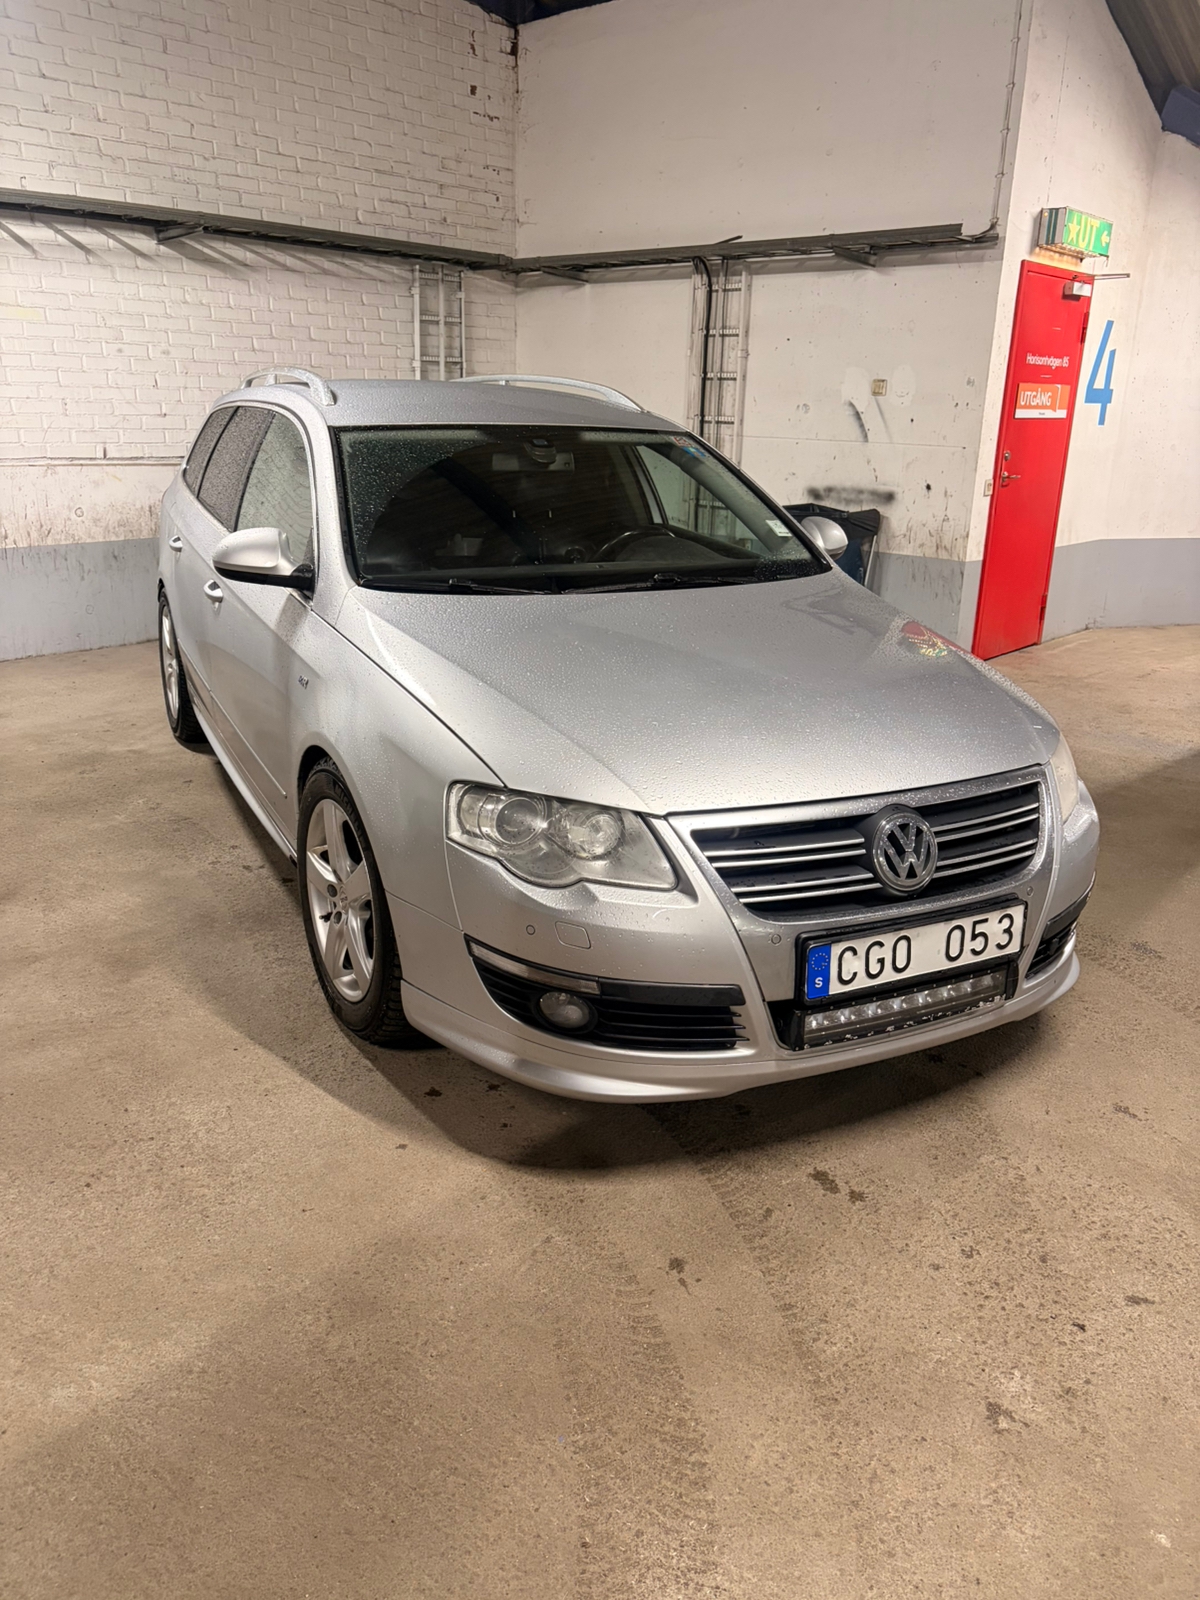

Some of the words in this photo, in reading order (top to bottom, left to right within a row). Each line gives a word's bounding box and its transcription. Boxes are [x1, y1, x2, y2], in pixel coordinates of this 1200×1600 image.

[1078, 215, 1100, 251] UT
[1062, 356, 1069, 367] 85
[1084, 320, 1116, 426] 4
[1020, 388, 1052, 406] UTGÅNG
[945, 913, 1014, 962] 053
[814, 977, 823, 988] S
